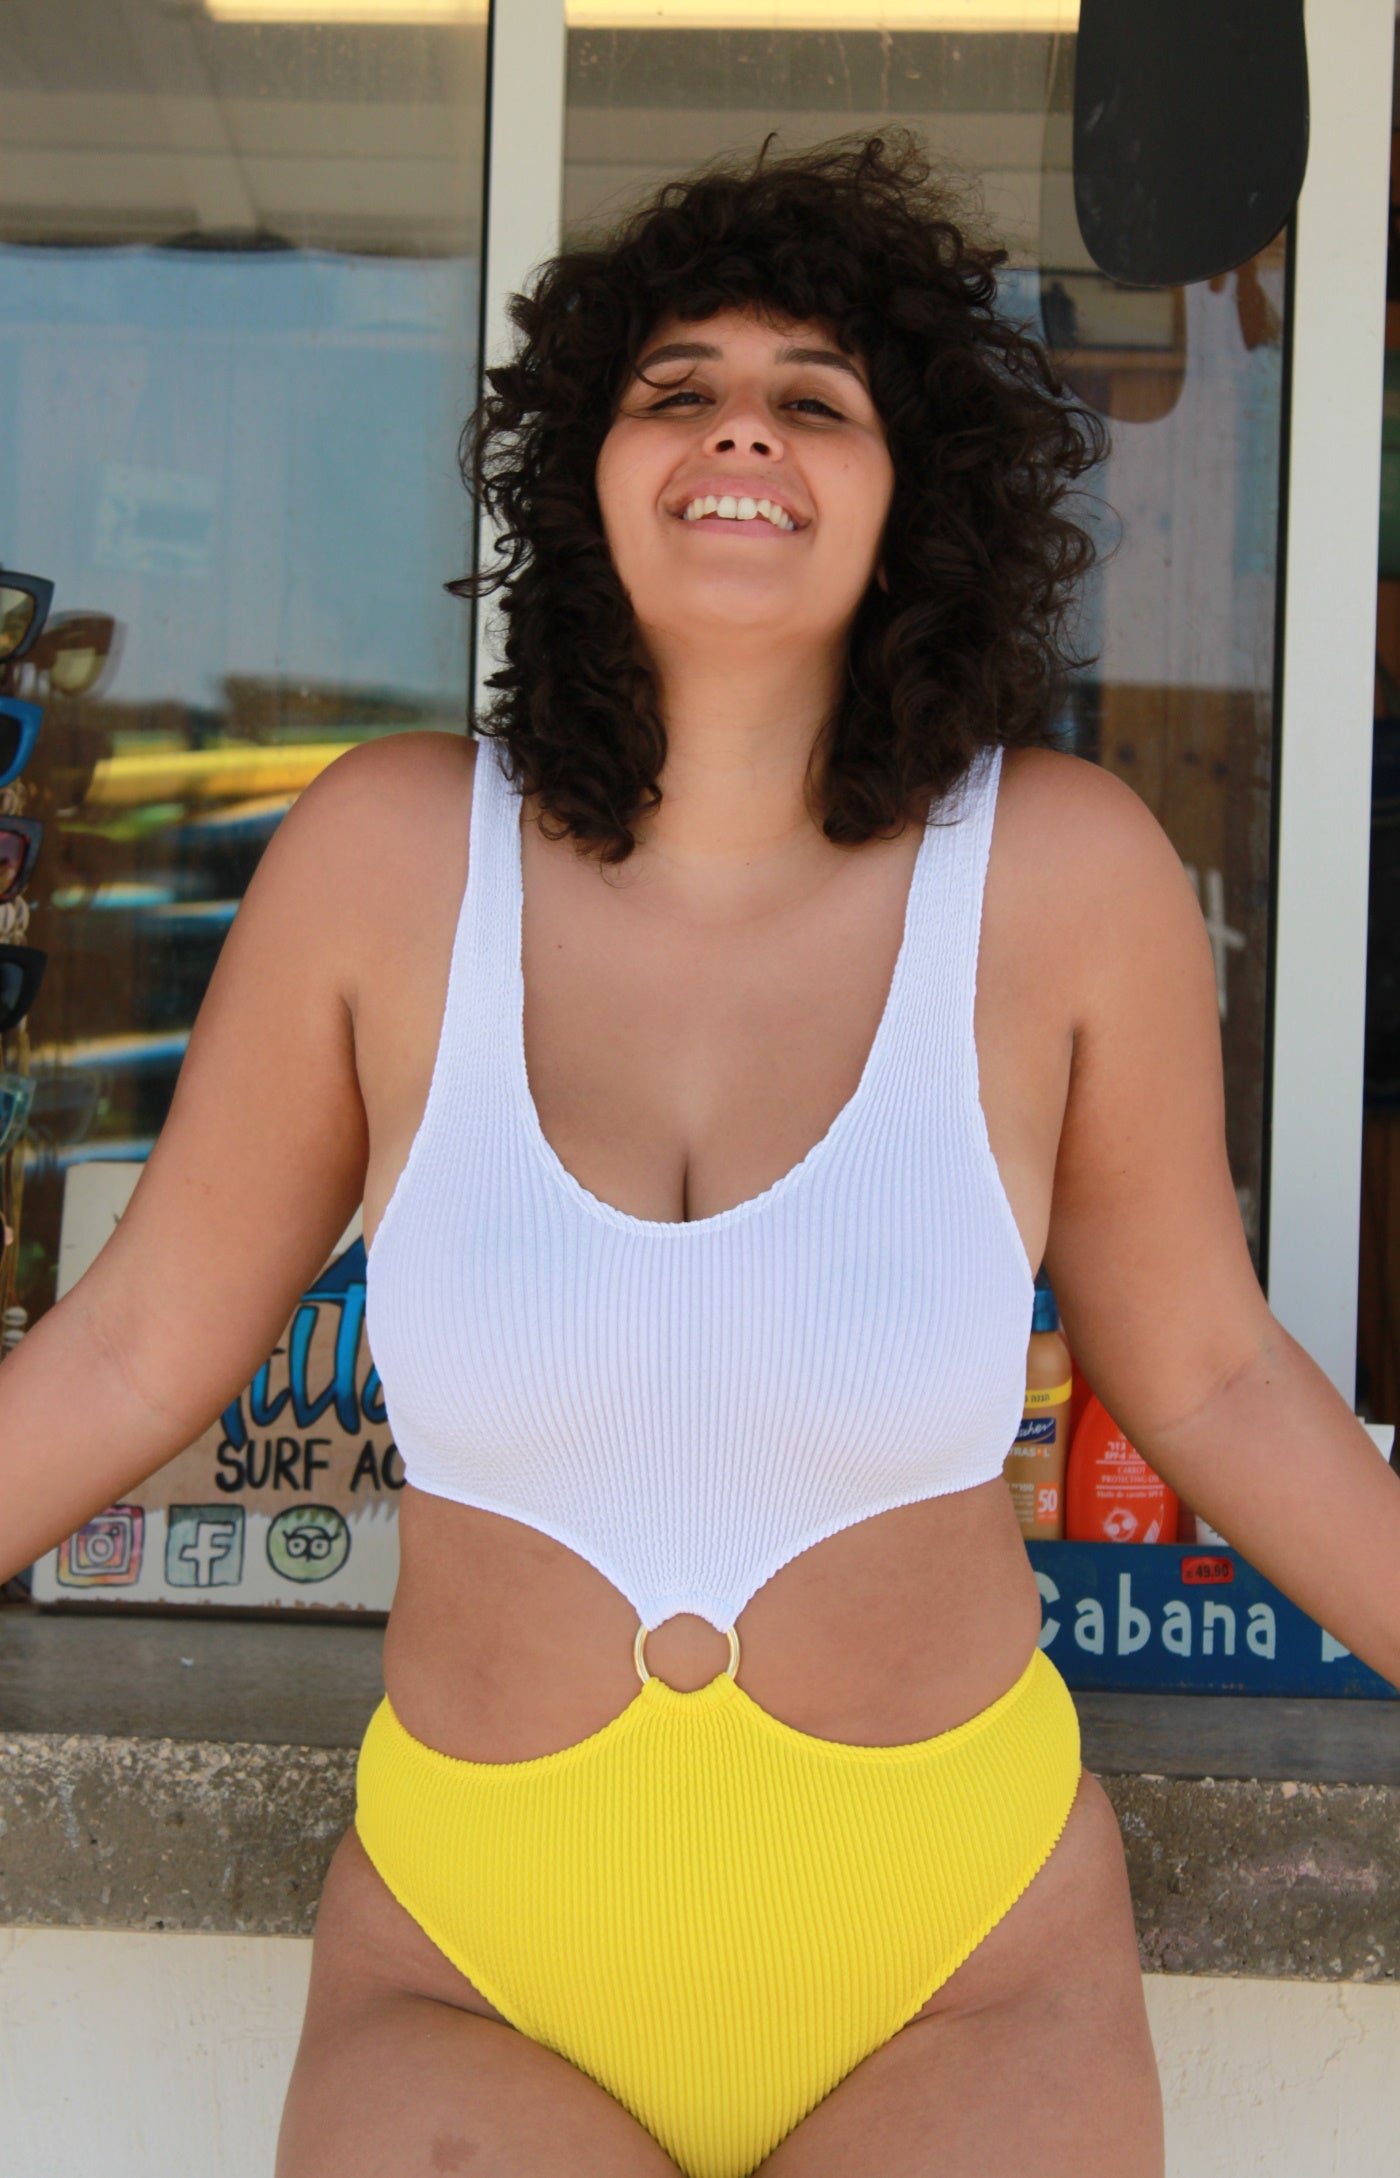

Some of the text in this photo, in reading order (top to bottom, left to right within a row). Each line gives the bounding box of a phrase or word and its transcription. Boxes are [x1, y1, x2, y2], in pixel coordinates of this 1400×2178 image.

[215, 1436, 332, 1493] SURF
[1101, 1475, 1147, 1483] PROTECTING
[1038, 1488, 1058, 1513] 50
